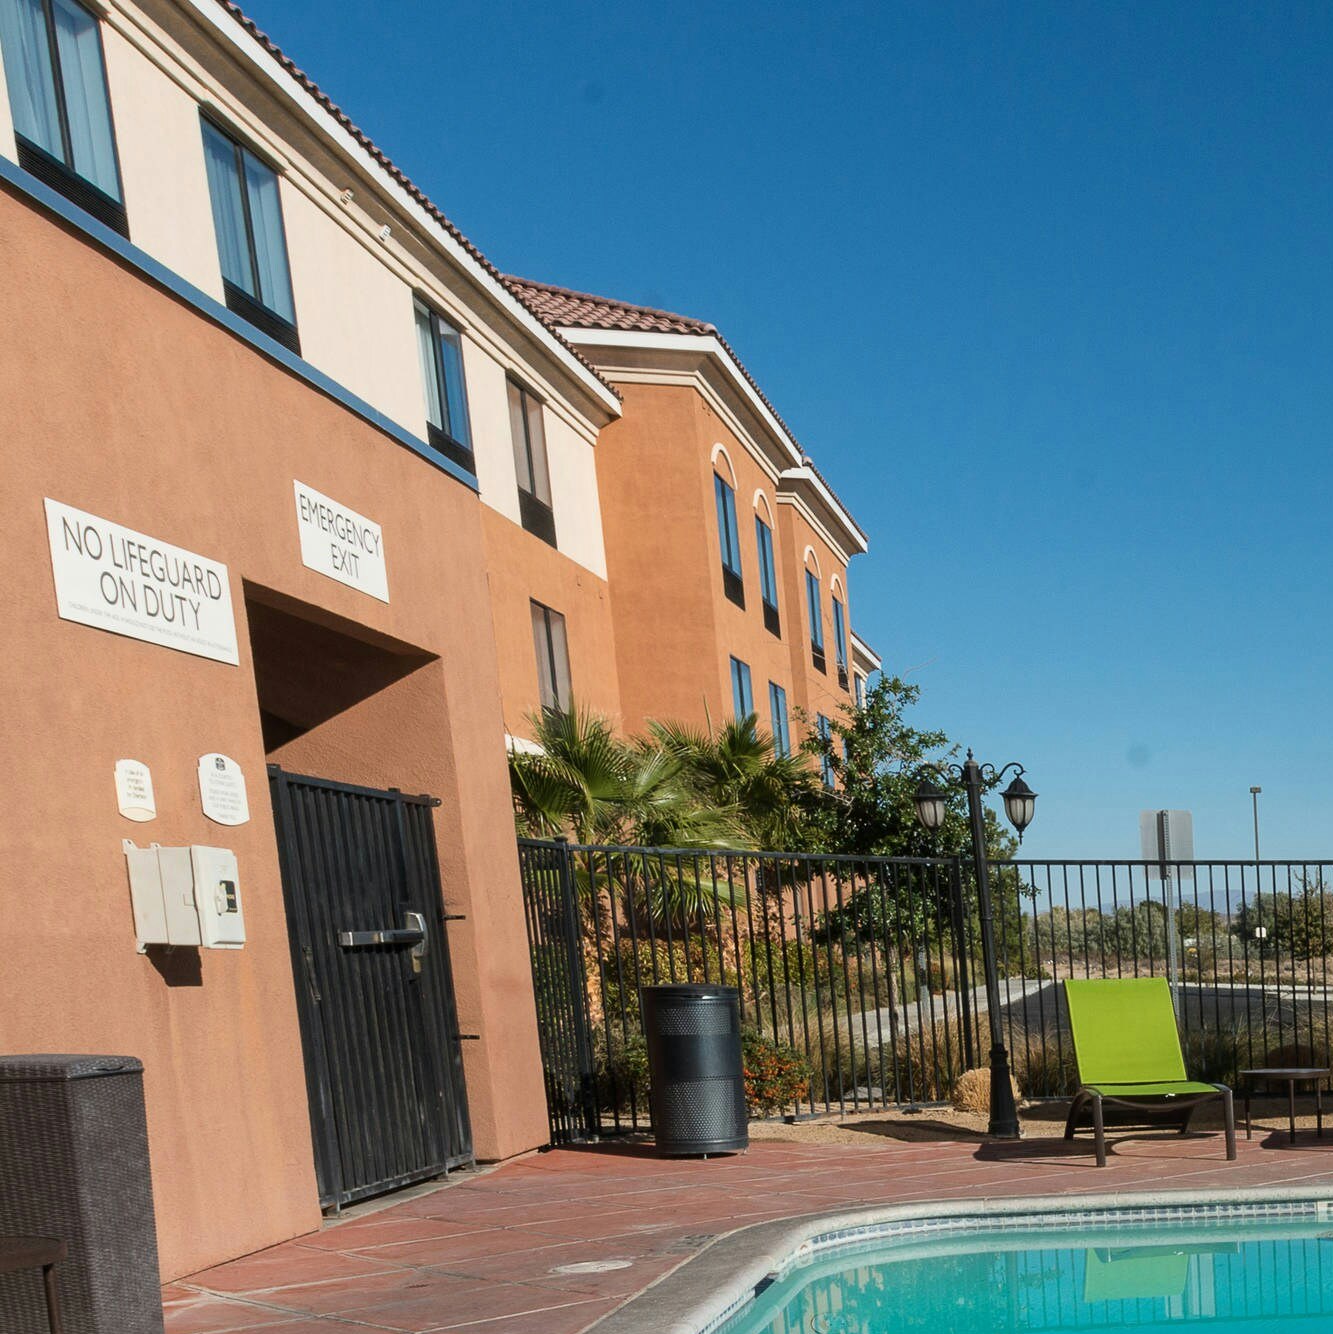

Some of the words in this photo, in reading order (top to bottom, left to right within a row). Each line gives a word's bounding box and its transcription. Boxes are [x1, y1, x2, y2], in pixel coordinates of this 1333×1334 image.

[300, 494, 380, 558] EMERGENCY
[62, 516, 102, 560] NO
[110, 533, 222, 600] LIFEGUARD
[331, 546, 360, 579] EXIT
[100, 570, 138, 612] ON
[144, 584, 201, 631] DUTY
